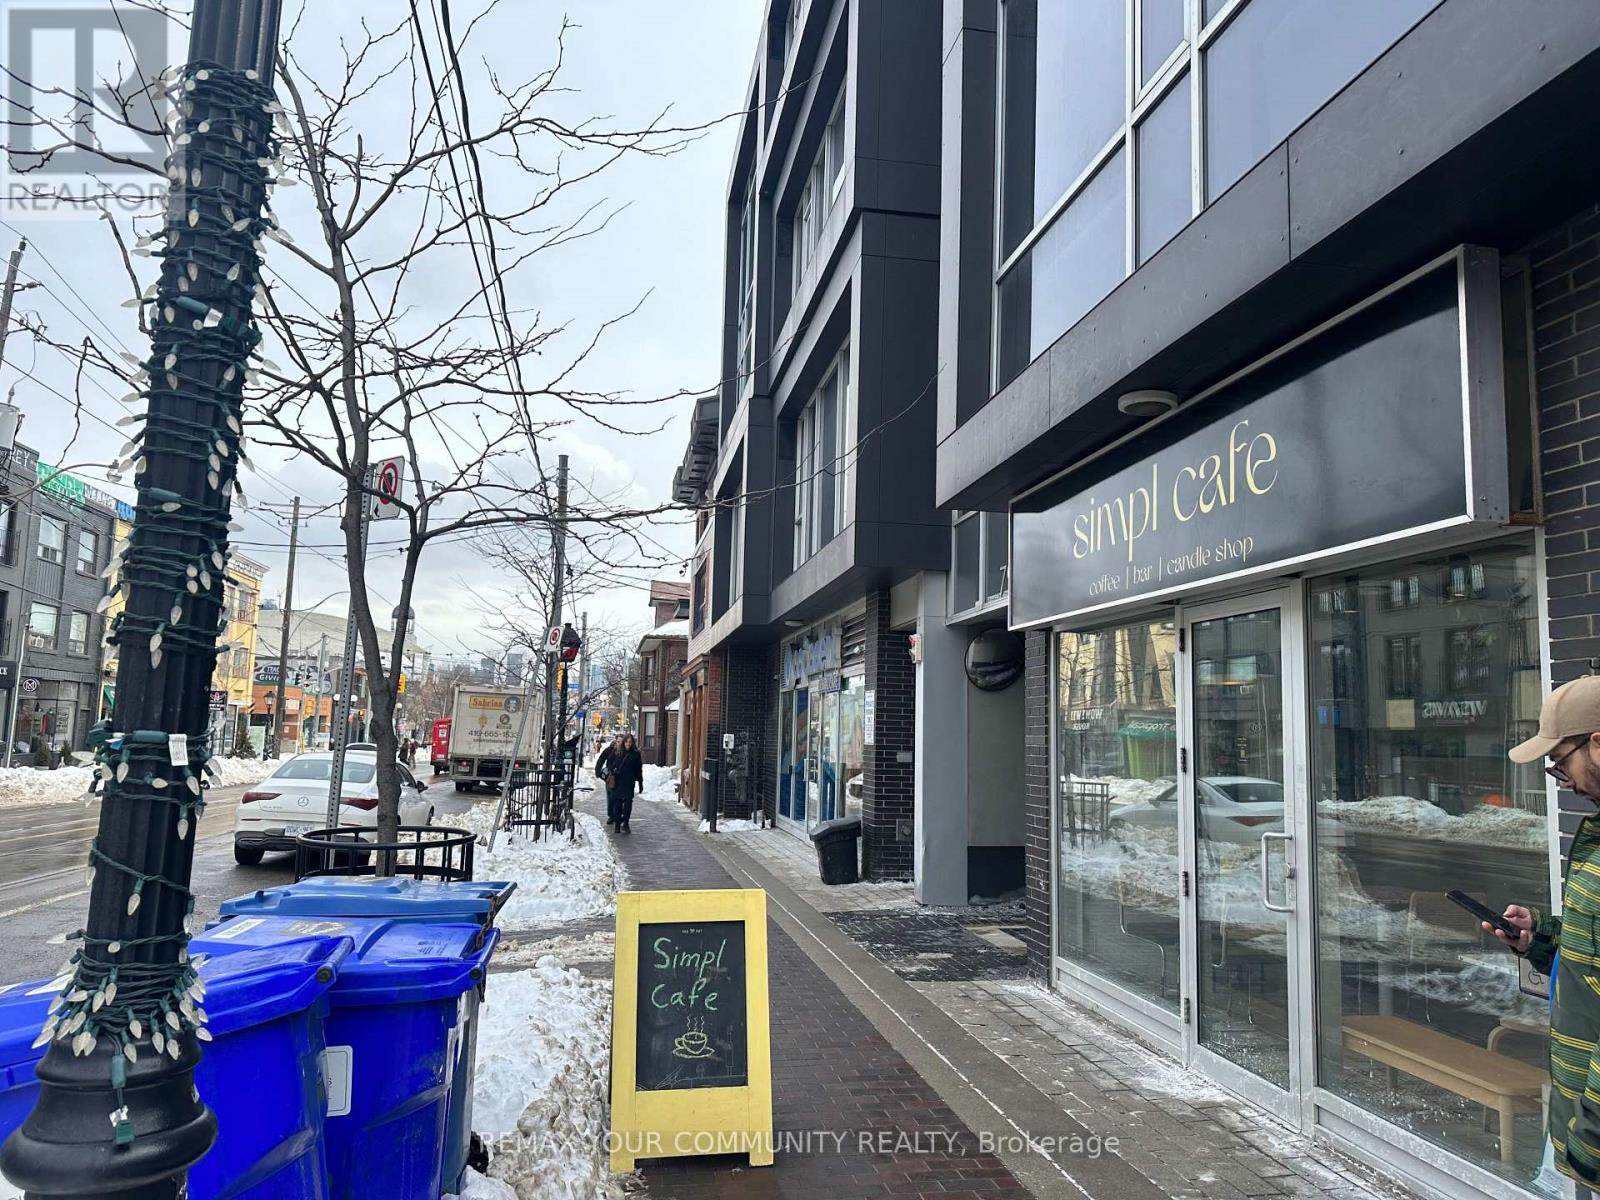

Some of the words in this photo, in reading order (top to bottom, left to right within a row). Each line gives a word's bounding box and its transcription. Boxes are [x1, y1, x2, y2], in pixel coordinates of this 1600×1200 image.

[1073, 463, 1158, 562] simpl
[1173, 420, 1278, 522] cafe
[1089, 574, 1120, 596] coffee
[1133, 565, 1153, 585] bar
[1166, 547, 1211, 575] candle
[1215, 536, 1253, 562] shop
[654, 937, 728, 979] Simpl
[652, 978, 719, 1011] Cafe
